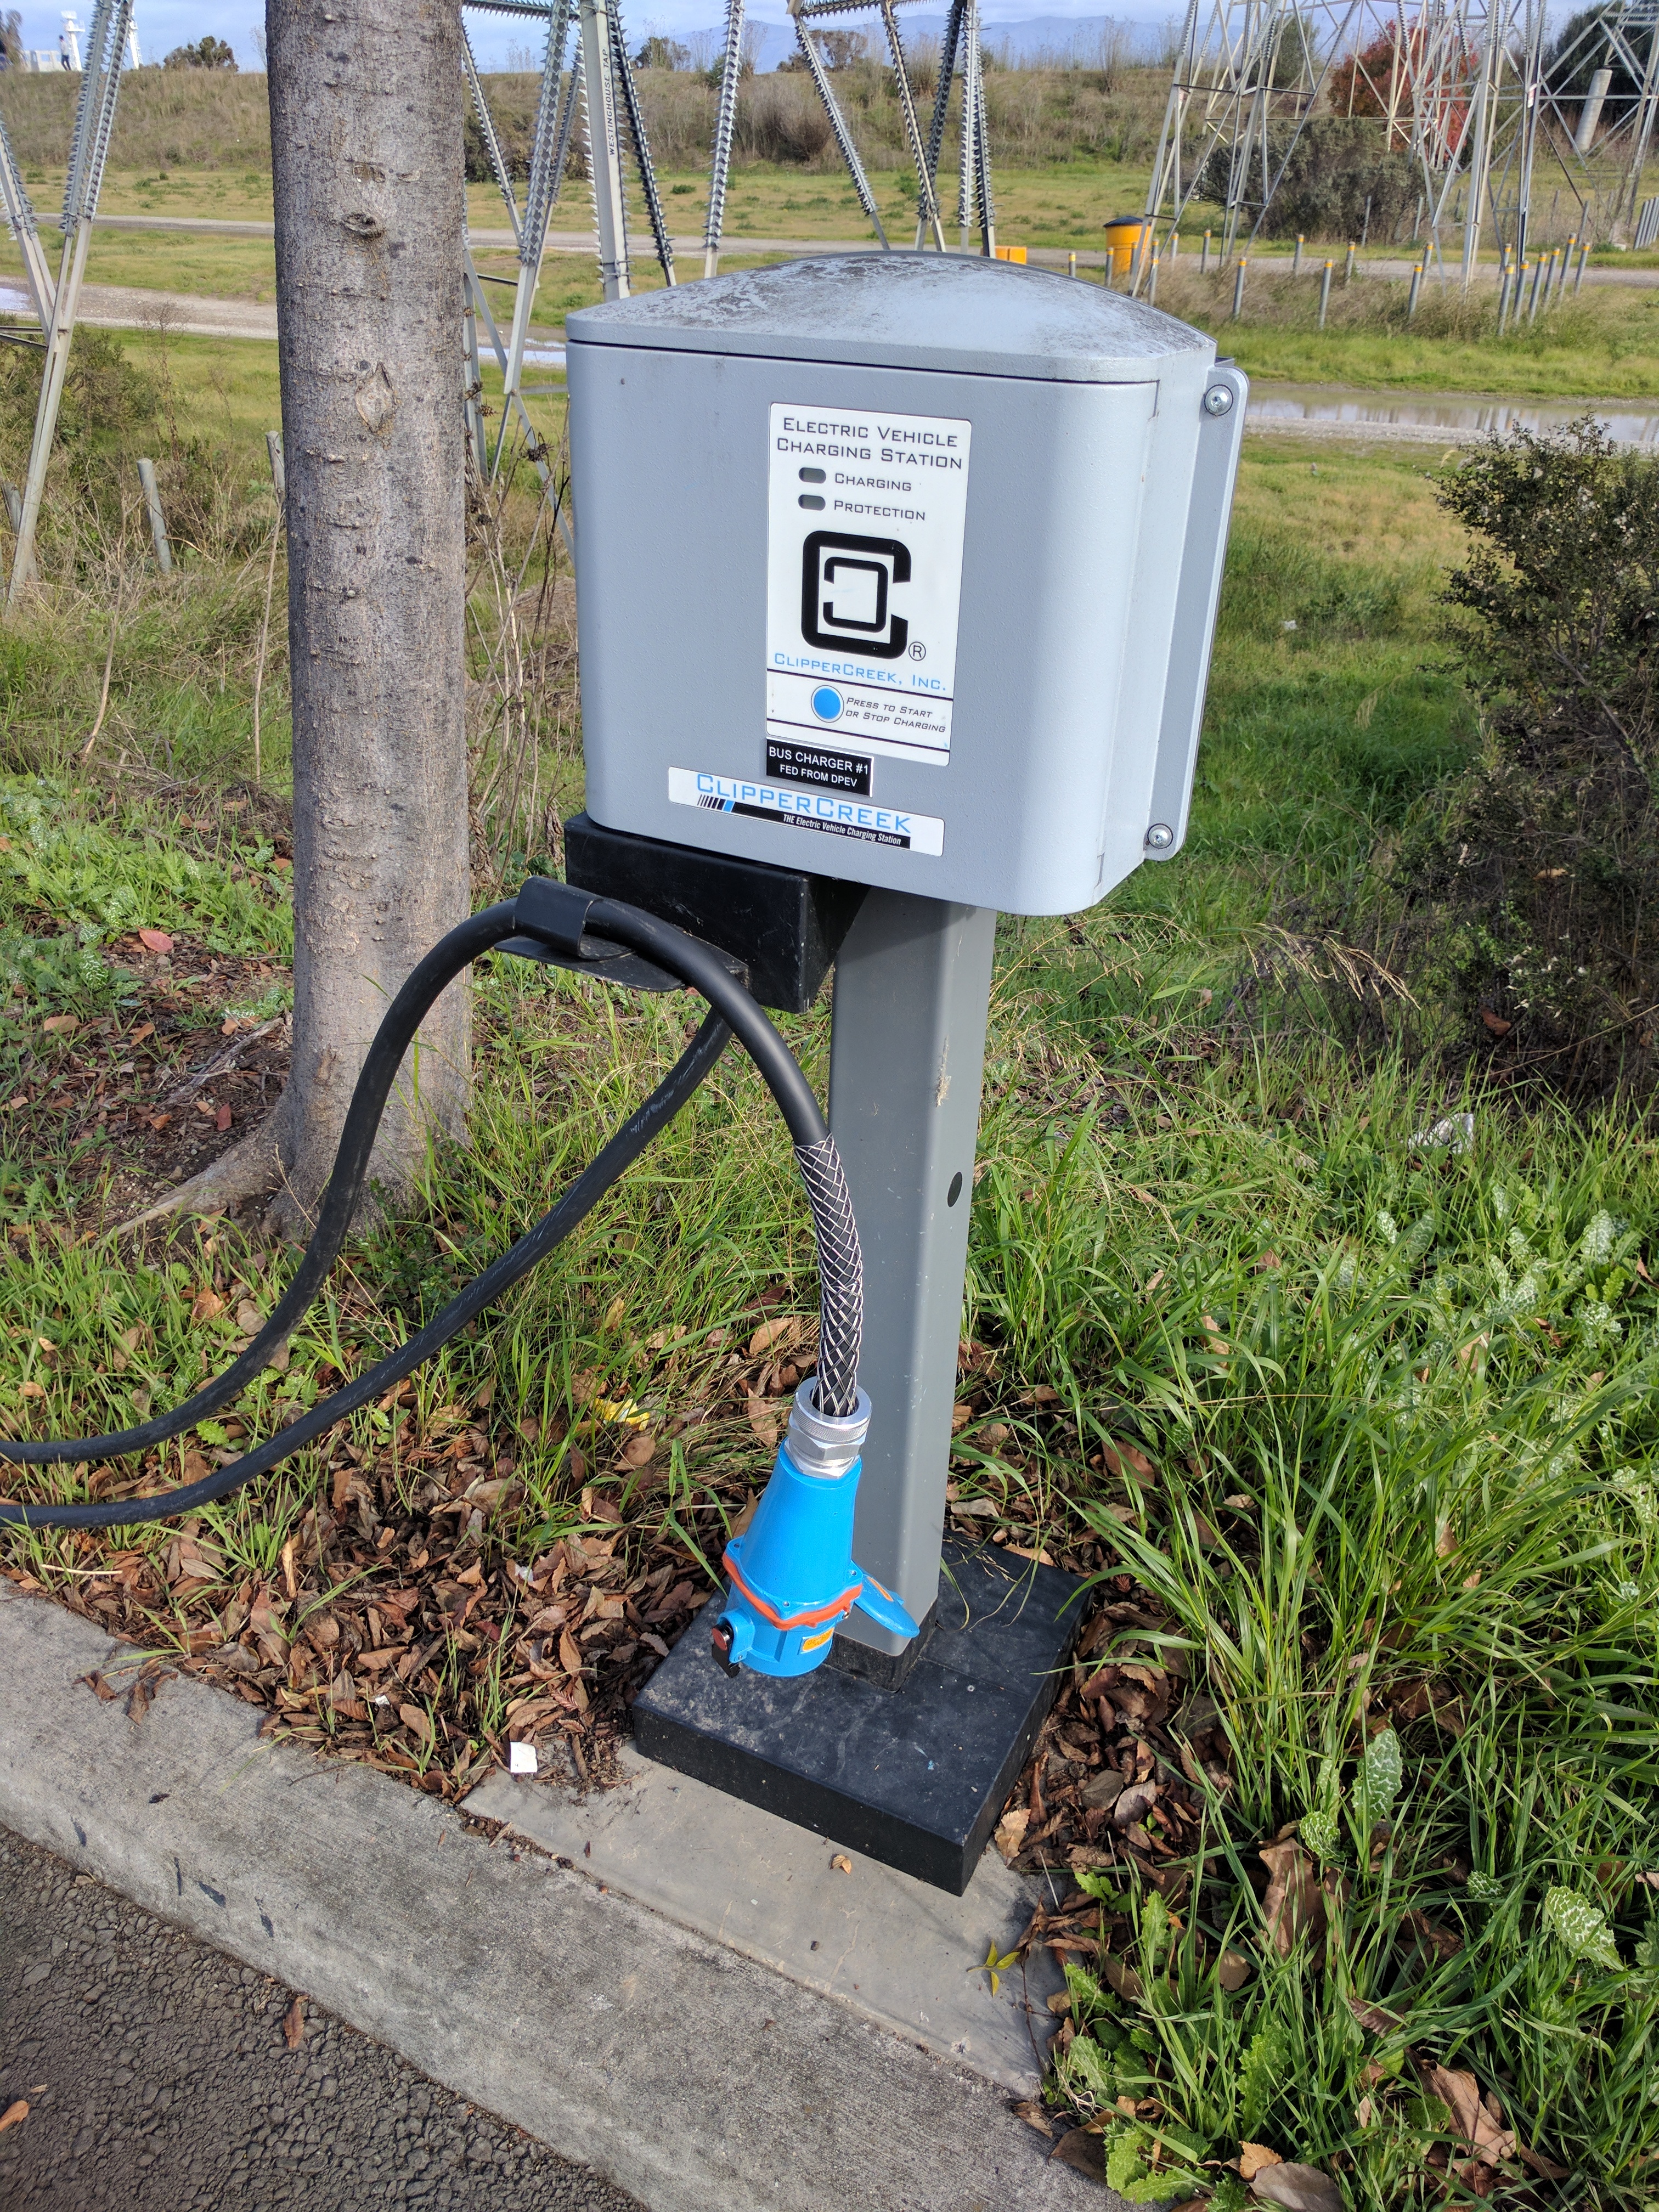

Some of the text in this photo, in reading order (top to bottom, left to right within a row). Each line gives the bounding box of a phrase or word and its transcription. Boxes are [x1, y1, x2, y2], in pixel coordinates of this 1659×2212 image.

[604, 75, 615, 155] WESTINGHOUSE
[783, 417, 958, 447] ELECTRIC VEHICLE
[777, 438, 962, 470] CHARGING STATION
[835, 473, 911, 492] CHARGING
[834, 500, 926, 521] PROTECTION
[846, 697, 879, 709] PRESS
[899, 706, 933, 718] START
[862, 712, 890, 723] STOP
[894, 718, 946, 733] CHARGING
[769, 746, 868, 775] BUS CHARGER #1
[780, 764, 857, 787] FED FROM DPEV
[783, 814, 901, 845] THE Electric Vehicle Charging Station
